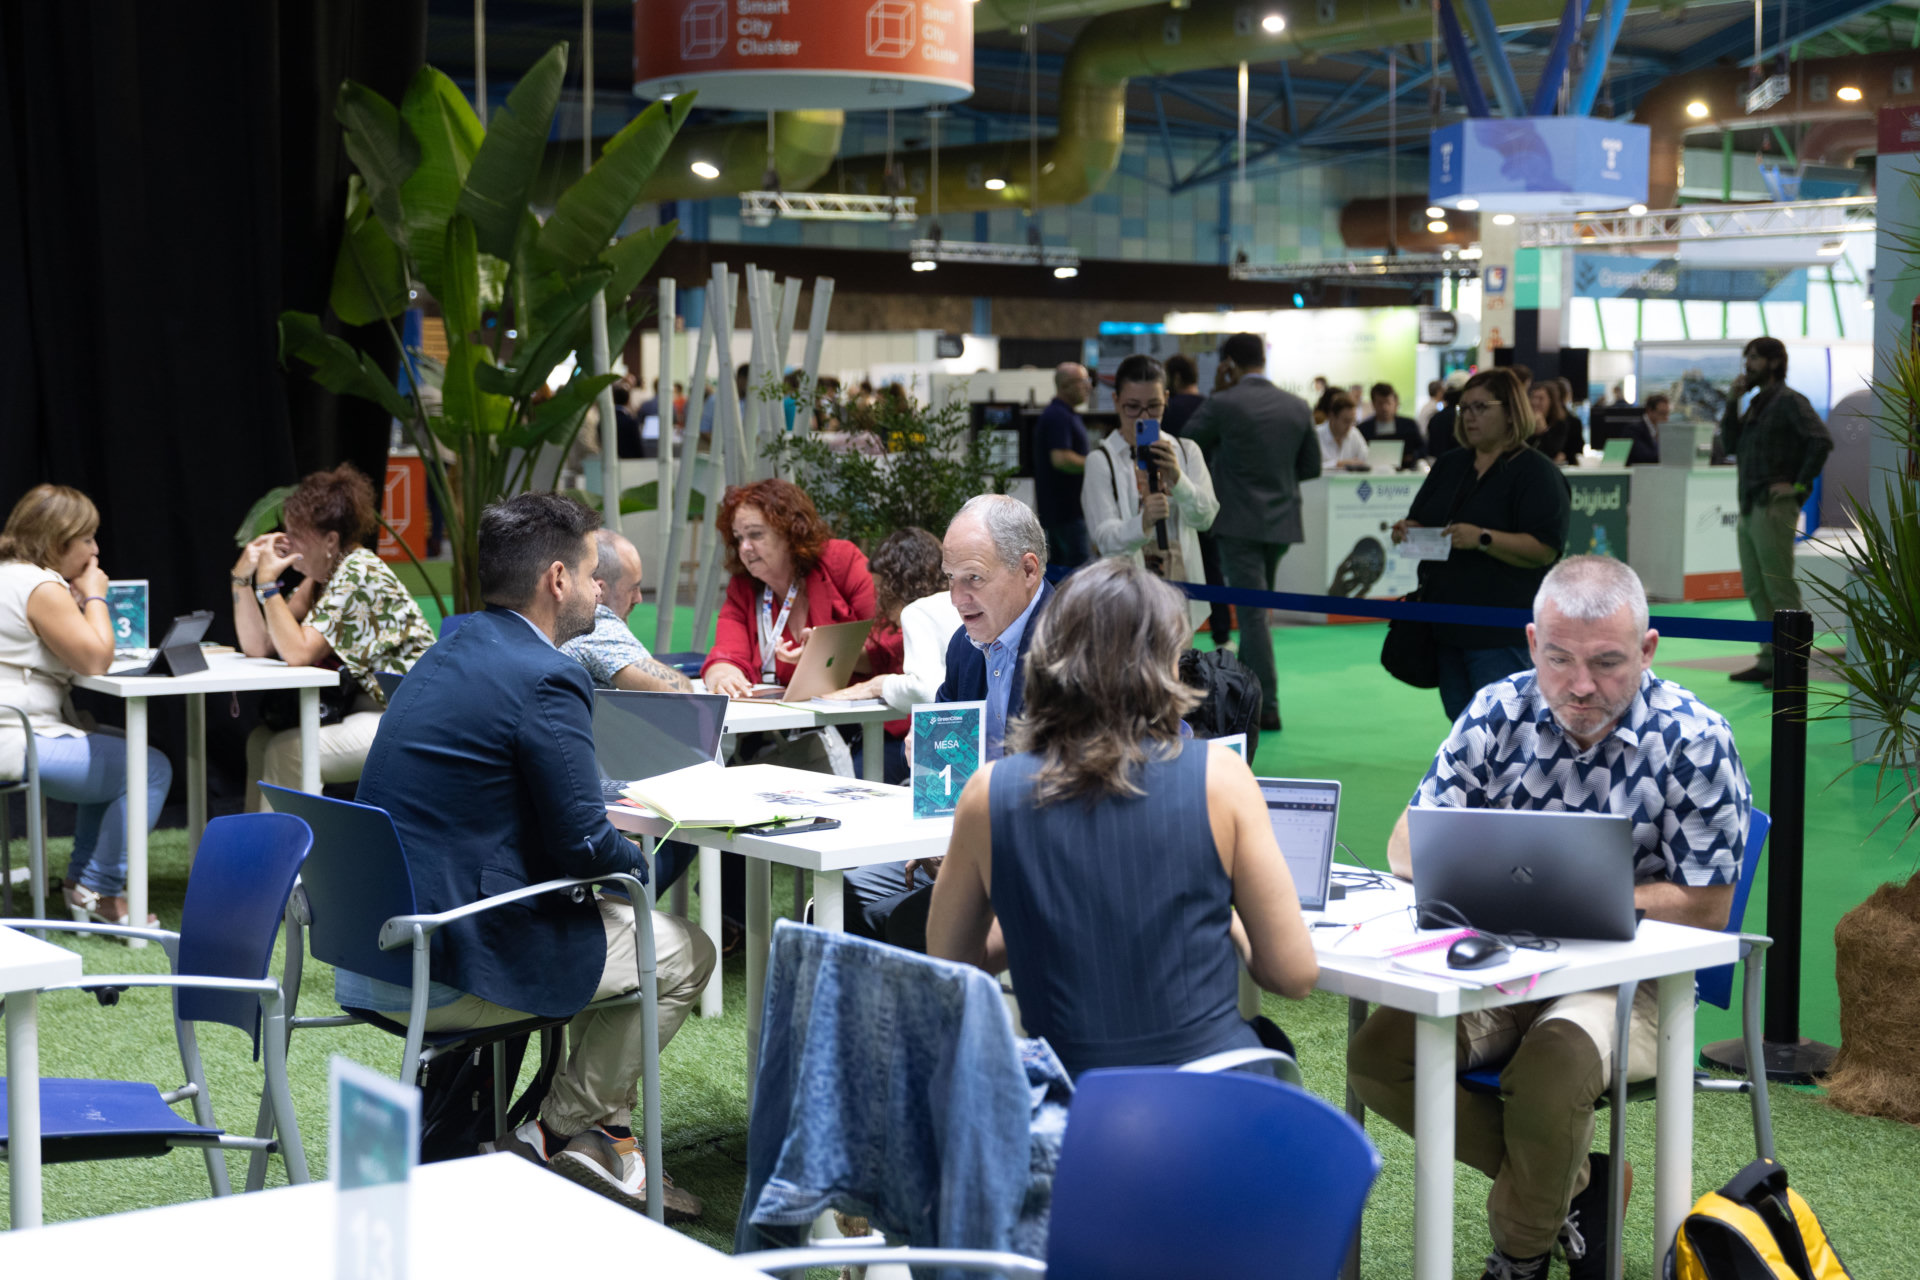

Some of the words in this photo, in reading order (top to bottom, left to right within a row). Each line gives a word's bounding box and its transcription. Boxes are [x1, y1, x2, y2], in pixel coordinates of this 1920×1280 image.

[736, 0, 790, 15] Smart
[736, 17, 773, 39] City
[921, 23, 946, 46] City
[736, 37, 802, 56] Cluster
[1598, 267, 1677, 291] GreenCities
[117, 616, 132, 638] 3
[934, 740, 960, 750] MESA
[939, 764, 952, 796] 1
